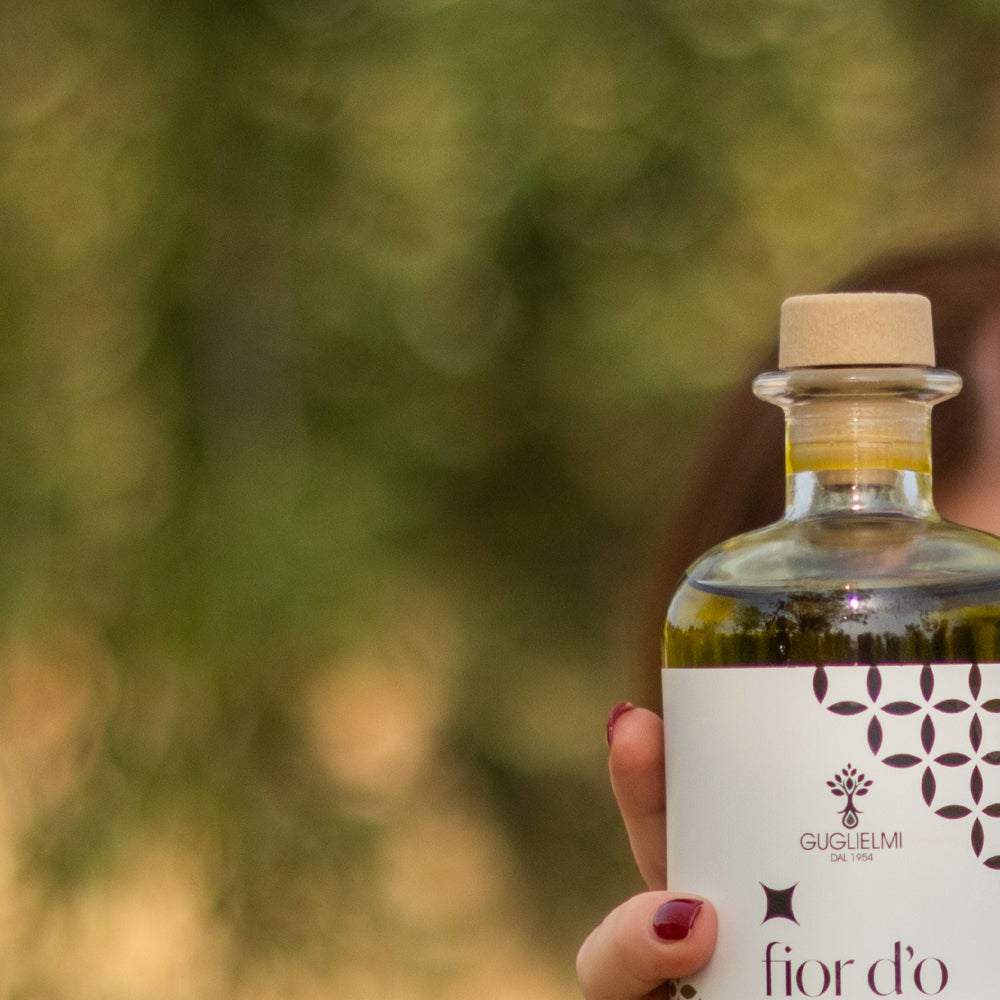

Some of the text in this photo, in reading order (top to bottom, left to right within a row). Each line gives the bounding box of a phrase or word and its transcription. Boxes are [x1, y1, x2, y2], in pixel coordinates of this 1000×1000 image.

[800, 832, 903, 850] GUGLIELMI
[830, 853, 873, 862] DAL 1954
[761, 941, 855, 997] fior
